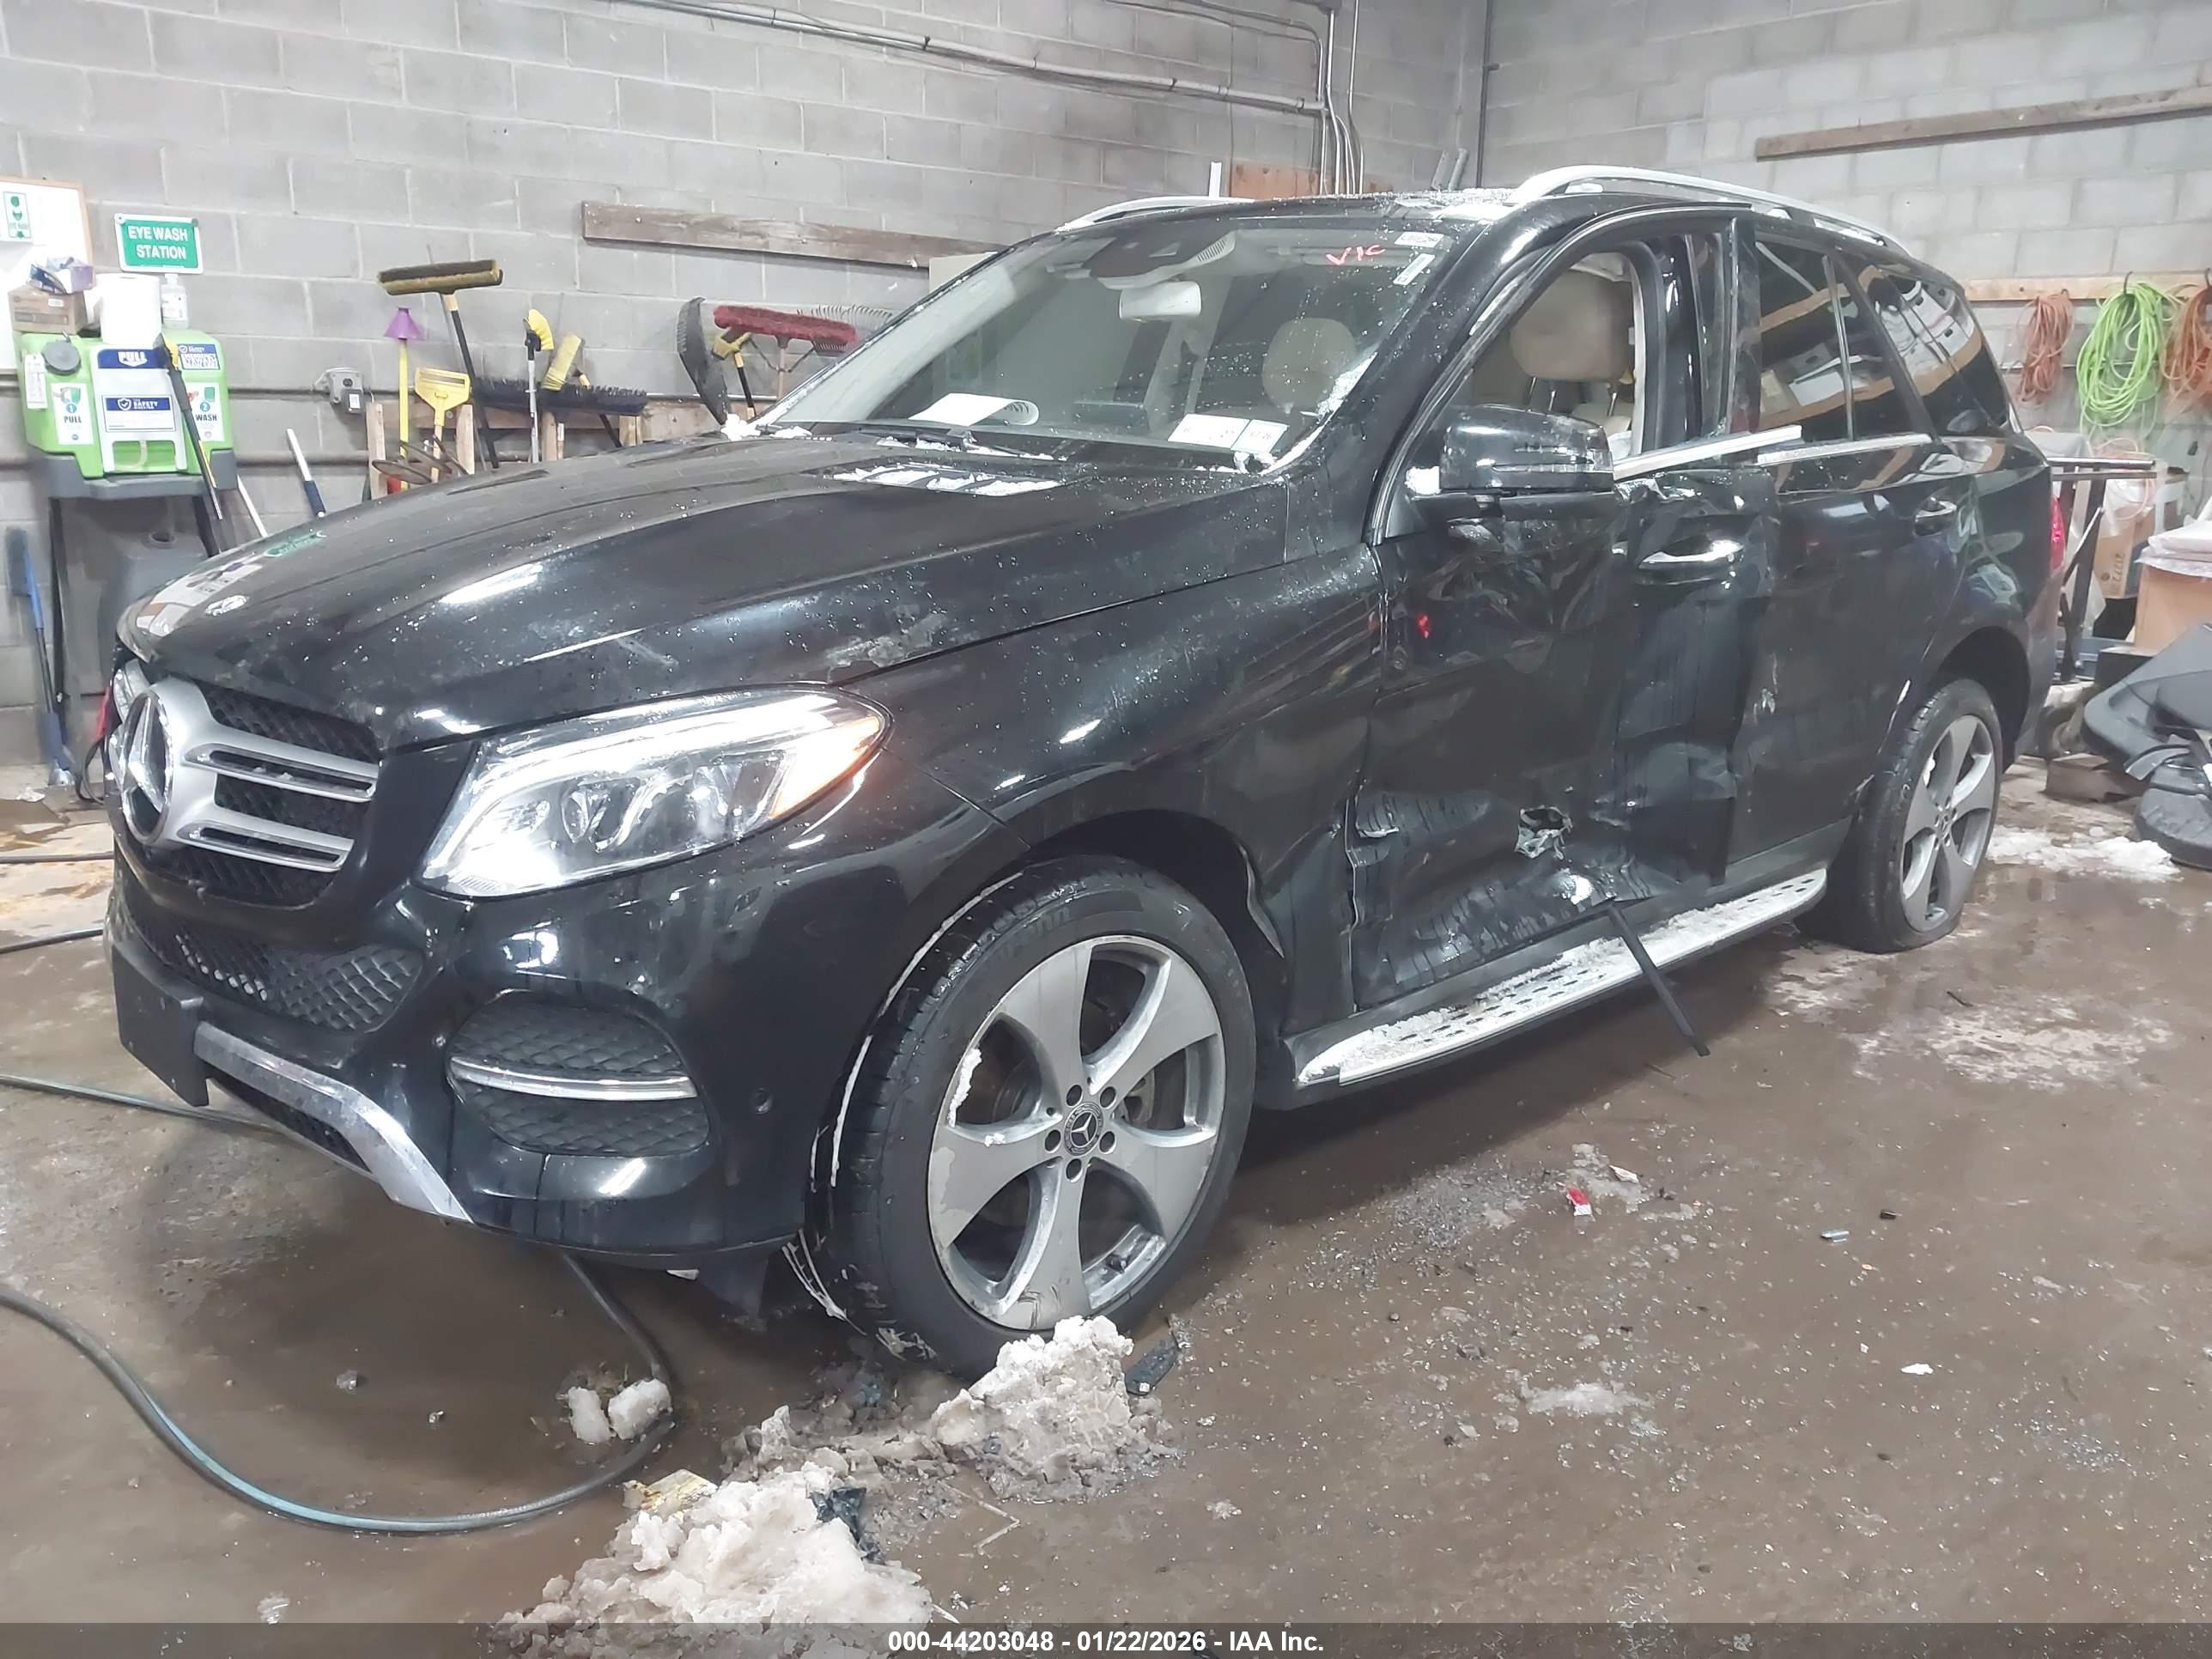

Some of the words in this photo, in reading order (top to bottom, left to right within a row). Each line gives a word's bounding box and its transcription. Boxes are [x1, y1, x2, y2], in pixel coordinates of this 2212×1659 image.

[127, 226, 152, 240] EYE
[153, 227, 188, 241] WASH
[137, 244, 186, 259] STATION
[118, 350, 147, 362] PULL
